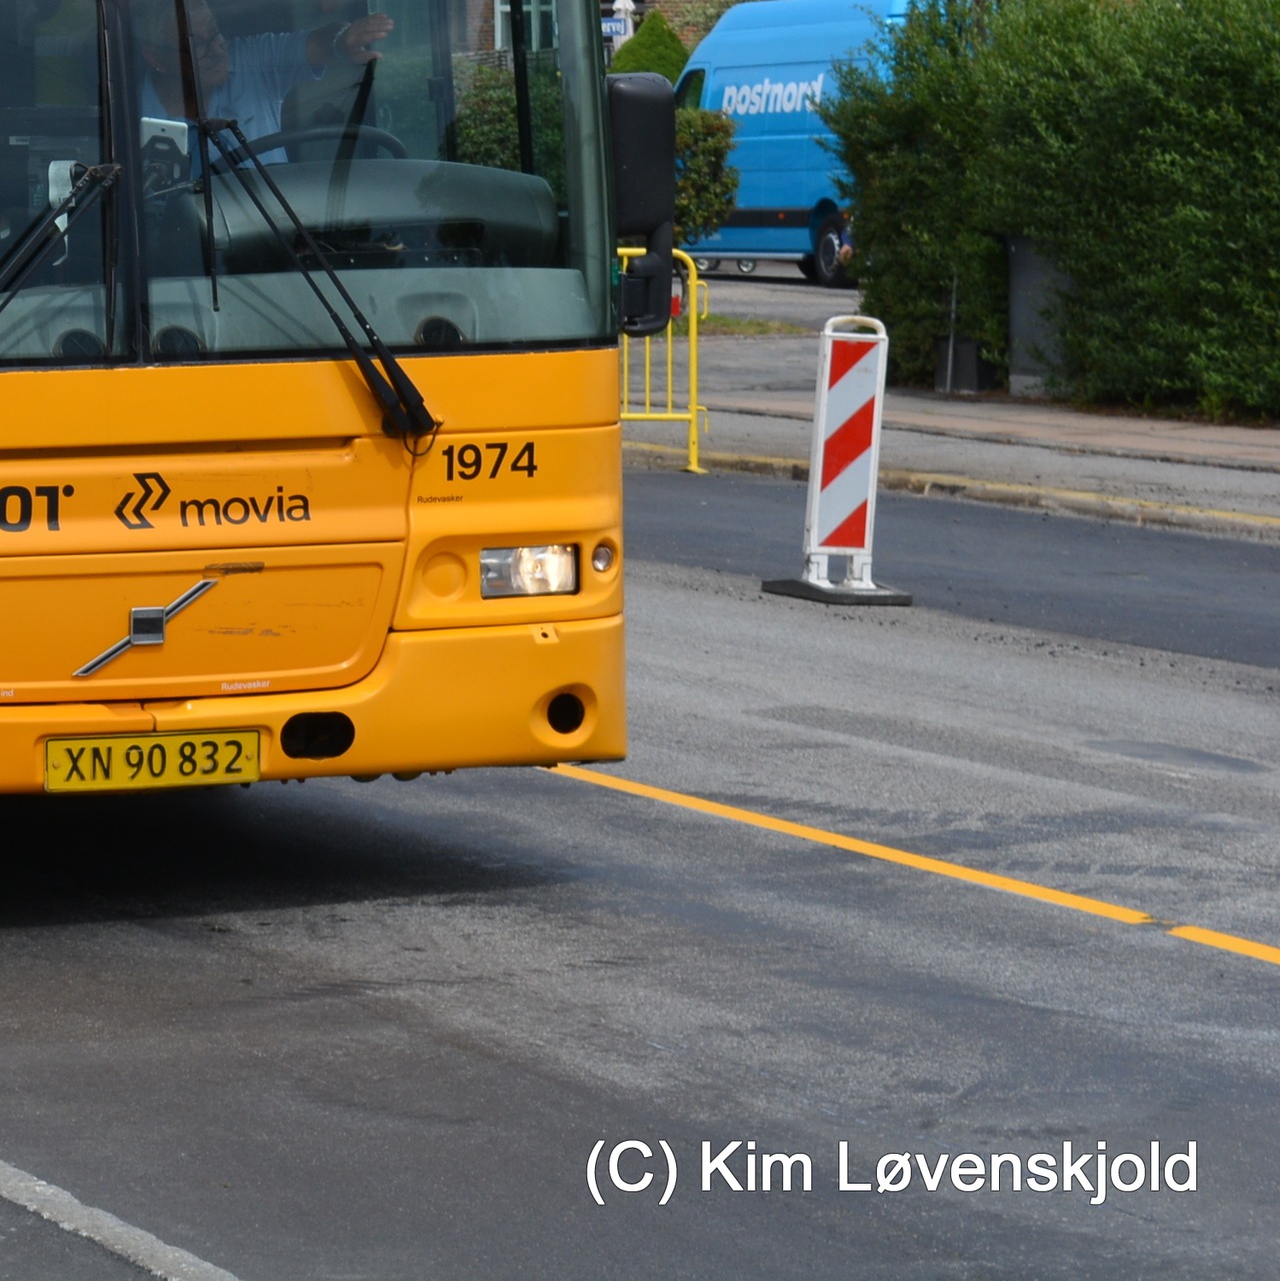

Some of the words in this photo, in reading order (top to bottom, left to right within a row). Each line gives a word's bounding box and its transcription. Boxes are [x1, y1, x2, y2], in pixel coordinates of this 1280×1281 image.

[442, 441, 538, 482] 1974
[179, 485, 311, 528] movia
[416, 494, 464, 504] Rudevasker
[0, 689, 14, 698] ind
[221, 680, 271, 691] Rudevasker
[64, 745, 113, 783] XN
[125, 742, 168, 781] 90
[178, 739, 244, 778] 832
